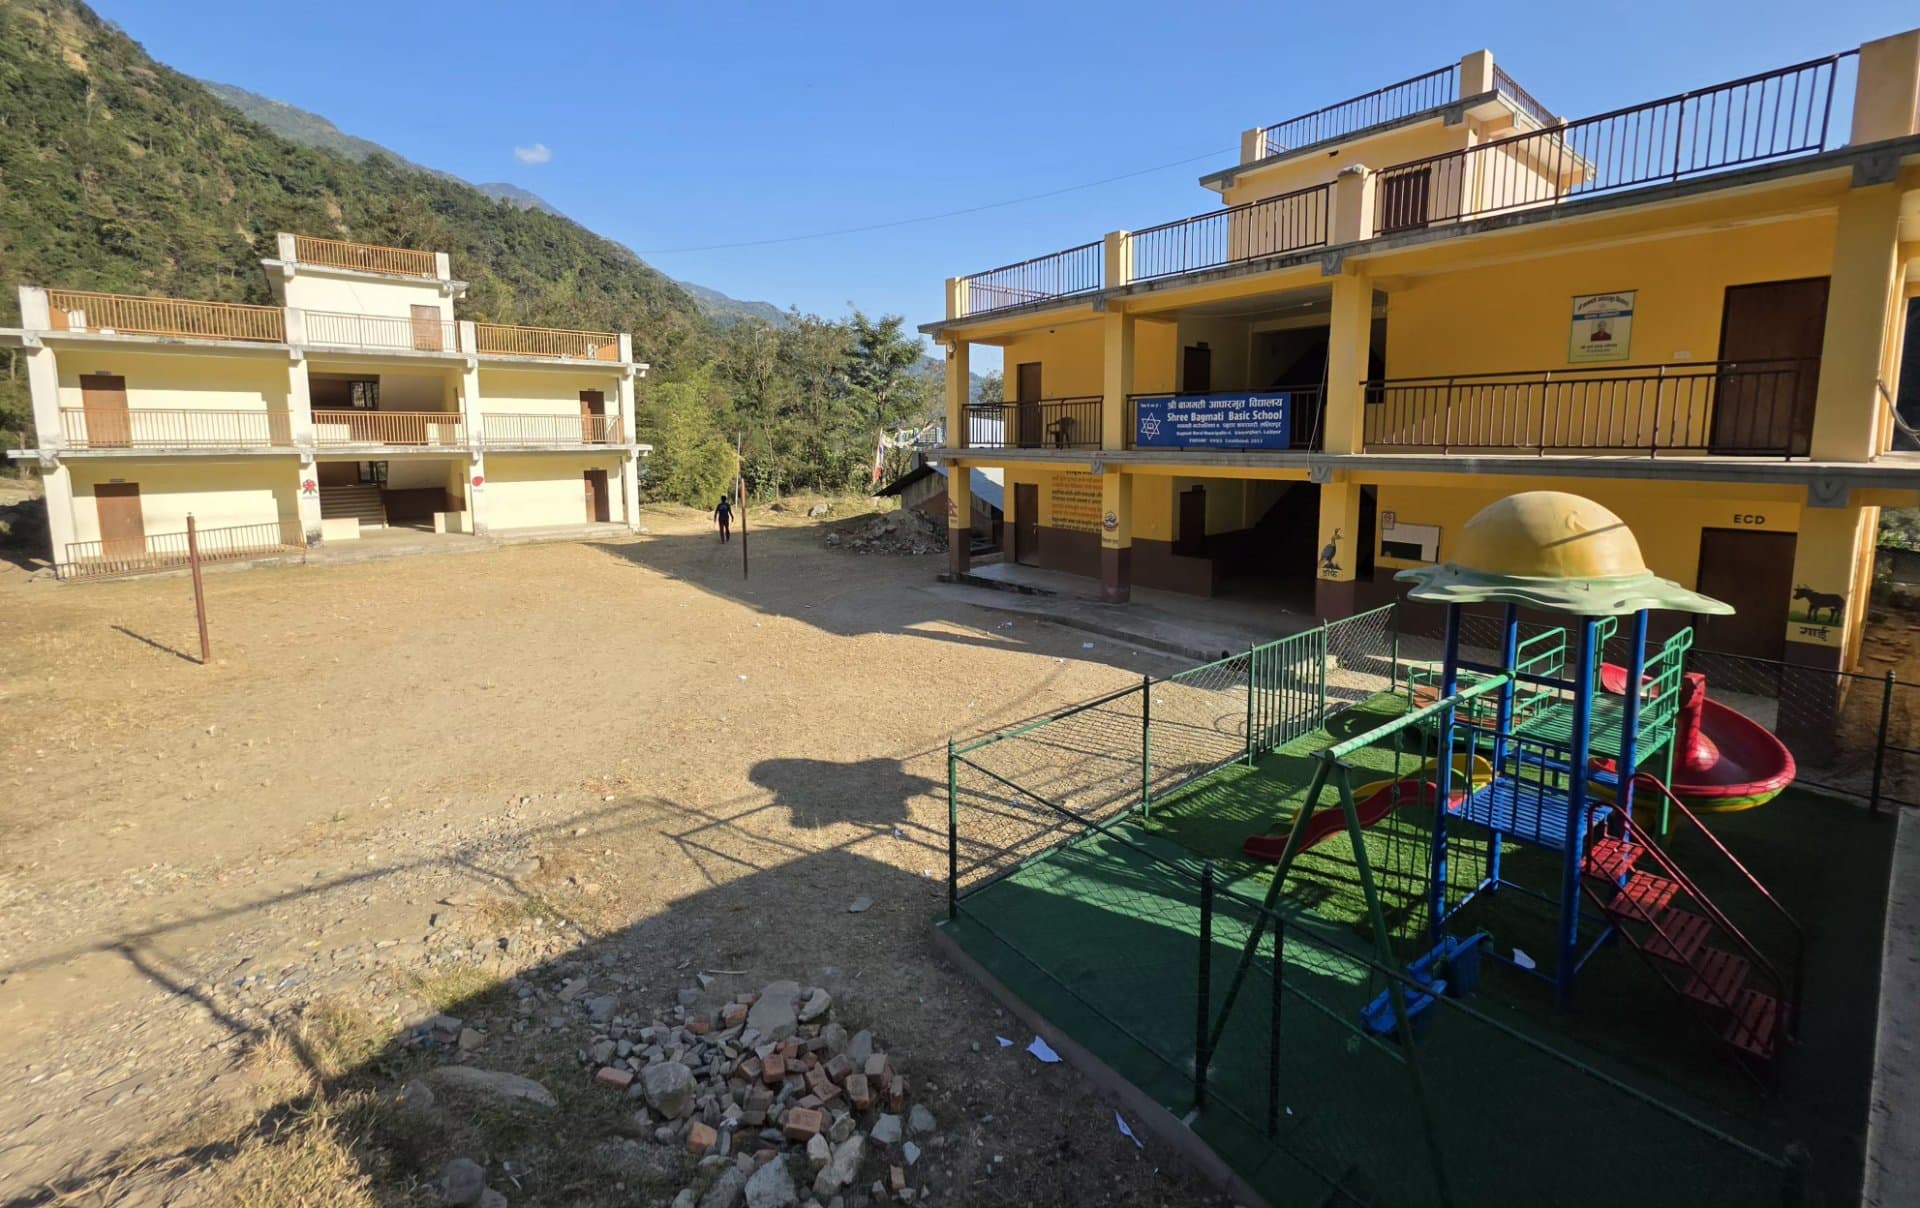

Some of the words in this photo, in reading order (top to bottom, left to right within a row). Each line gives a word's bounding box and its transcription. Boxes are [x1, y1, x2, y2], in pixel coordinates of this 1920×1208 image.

[1167, 399, 1177, 410] श्री
[1178, 399, 1206, 409] बागमती
[1208, 399, 1246, 410] आधारभूत
[1249, 397, 1283, 408] विद्यालय
[1167, 412, 1189, 422] Shree
[1191, 411, 1225, 423] Bagmati
[1228, 410, 1251, 421] Basic
[1252, 409, 1283, 420] School
[1733, 514, 1766, 524] ECD
